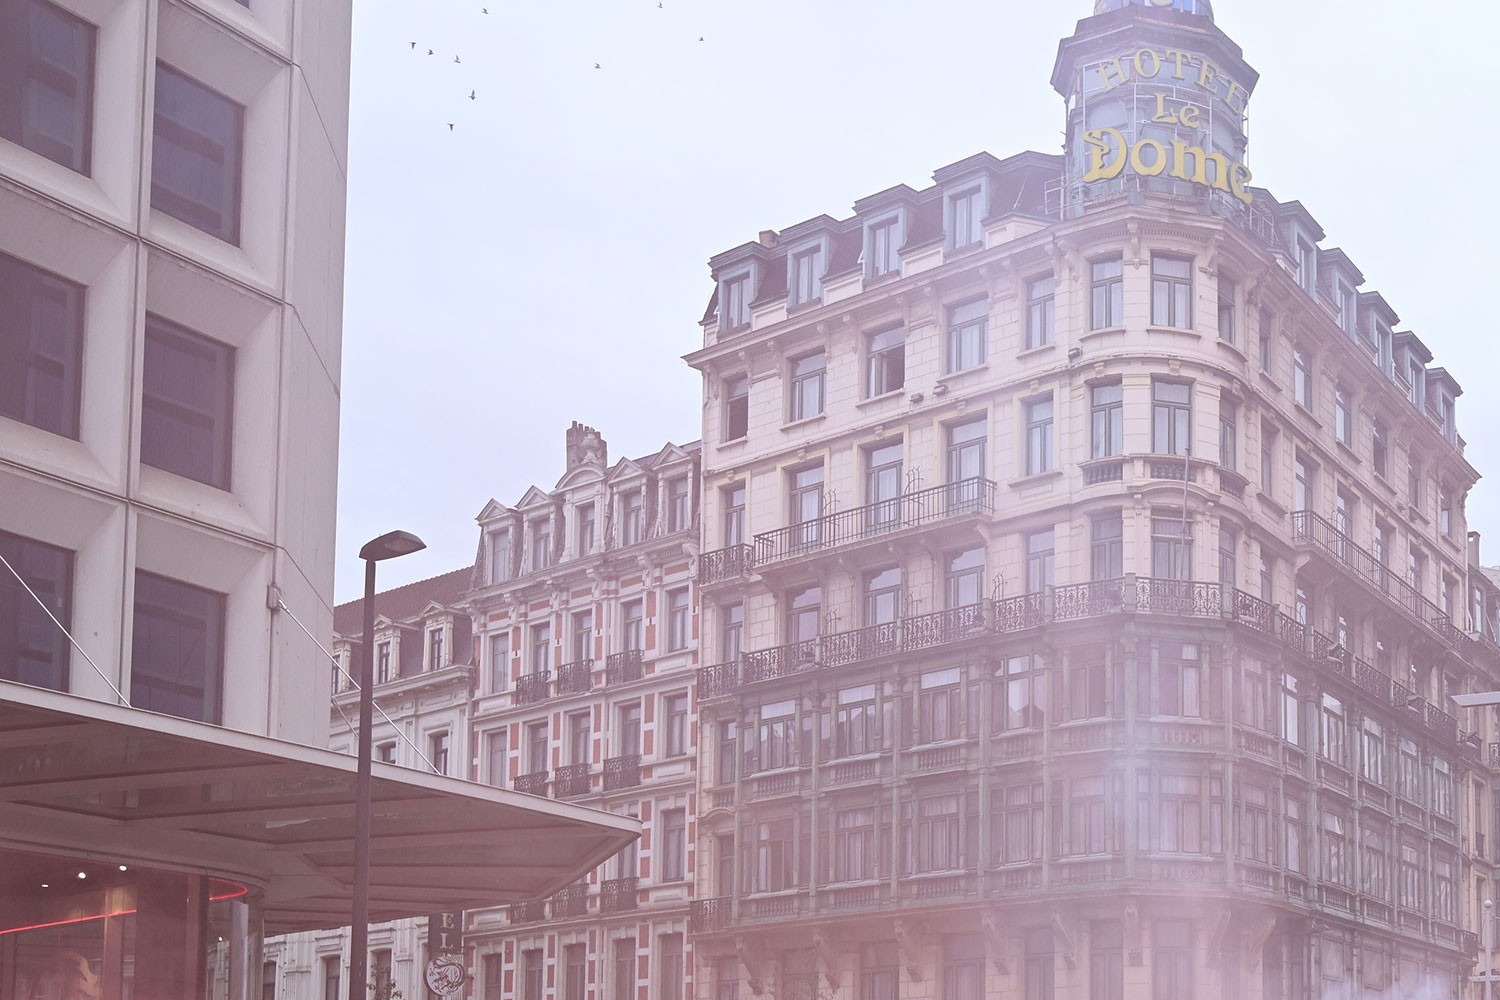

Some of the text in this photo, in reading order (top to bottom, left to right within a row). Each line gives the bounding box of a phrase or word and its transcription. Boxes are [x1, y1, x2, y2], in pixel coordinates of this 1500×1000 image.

[1096, 49, 1246, 117] HOTEL
[1152, 93, 1200, 128] Le
[1082, 128, 1254, 204] Dome
